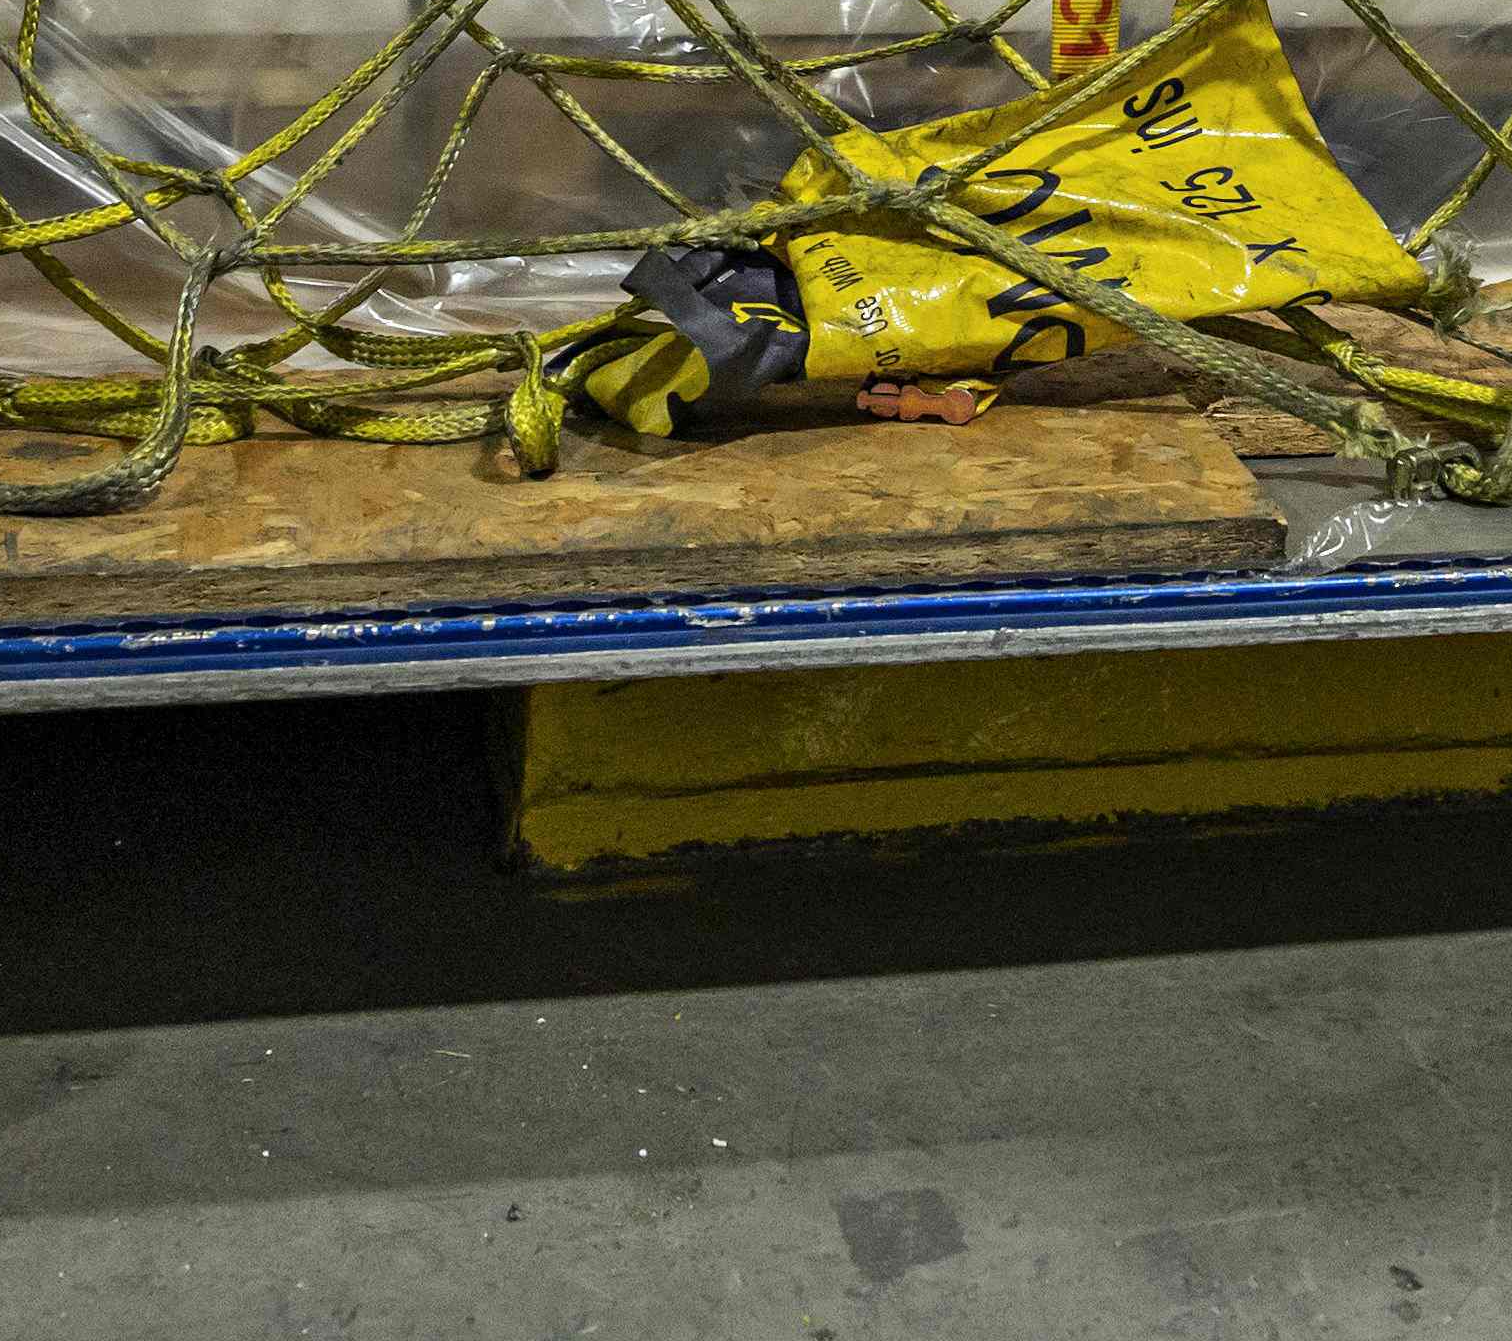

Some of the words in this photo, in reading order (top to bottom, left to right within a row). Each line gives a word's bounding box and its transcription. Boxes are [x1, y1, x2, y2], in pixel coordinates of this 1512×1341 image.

[1122, 75, 1204, 155] ins
[1160, 165, 1264, 221] 125
[821, 254, 867, 292] With
[855, 294, 891, 339] Use
